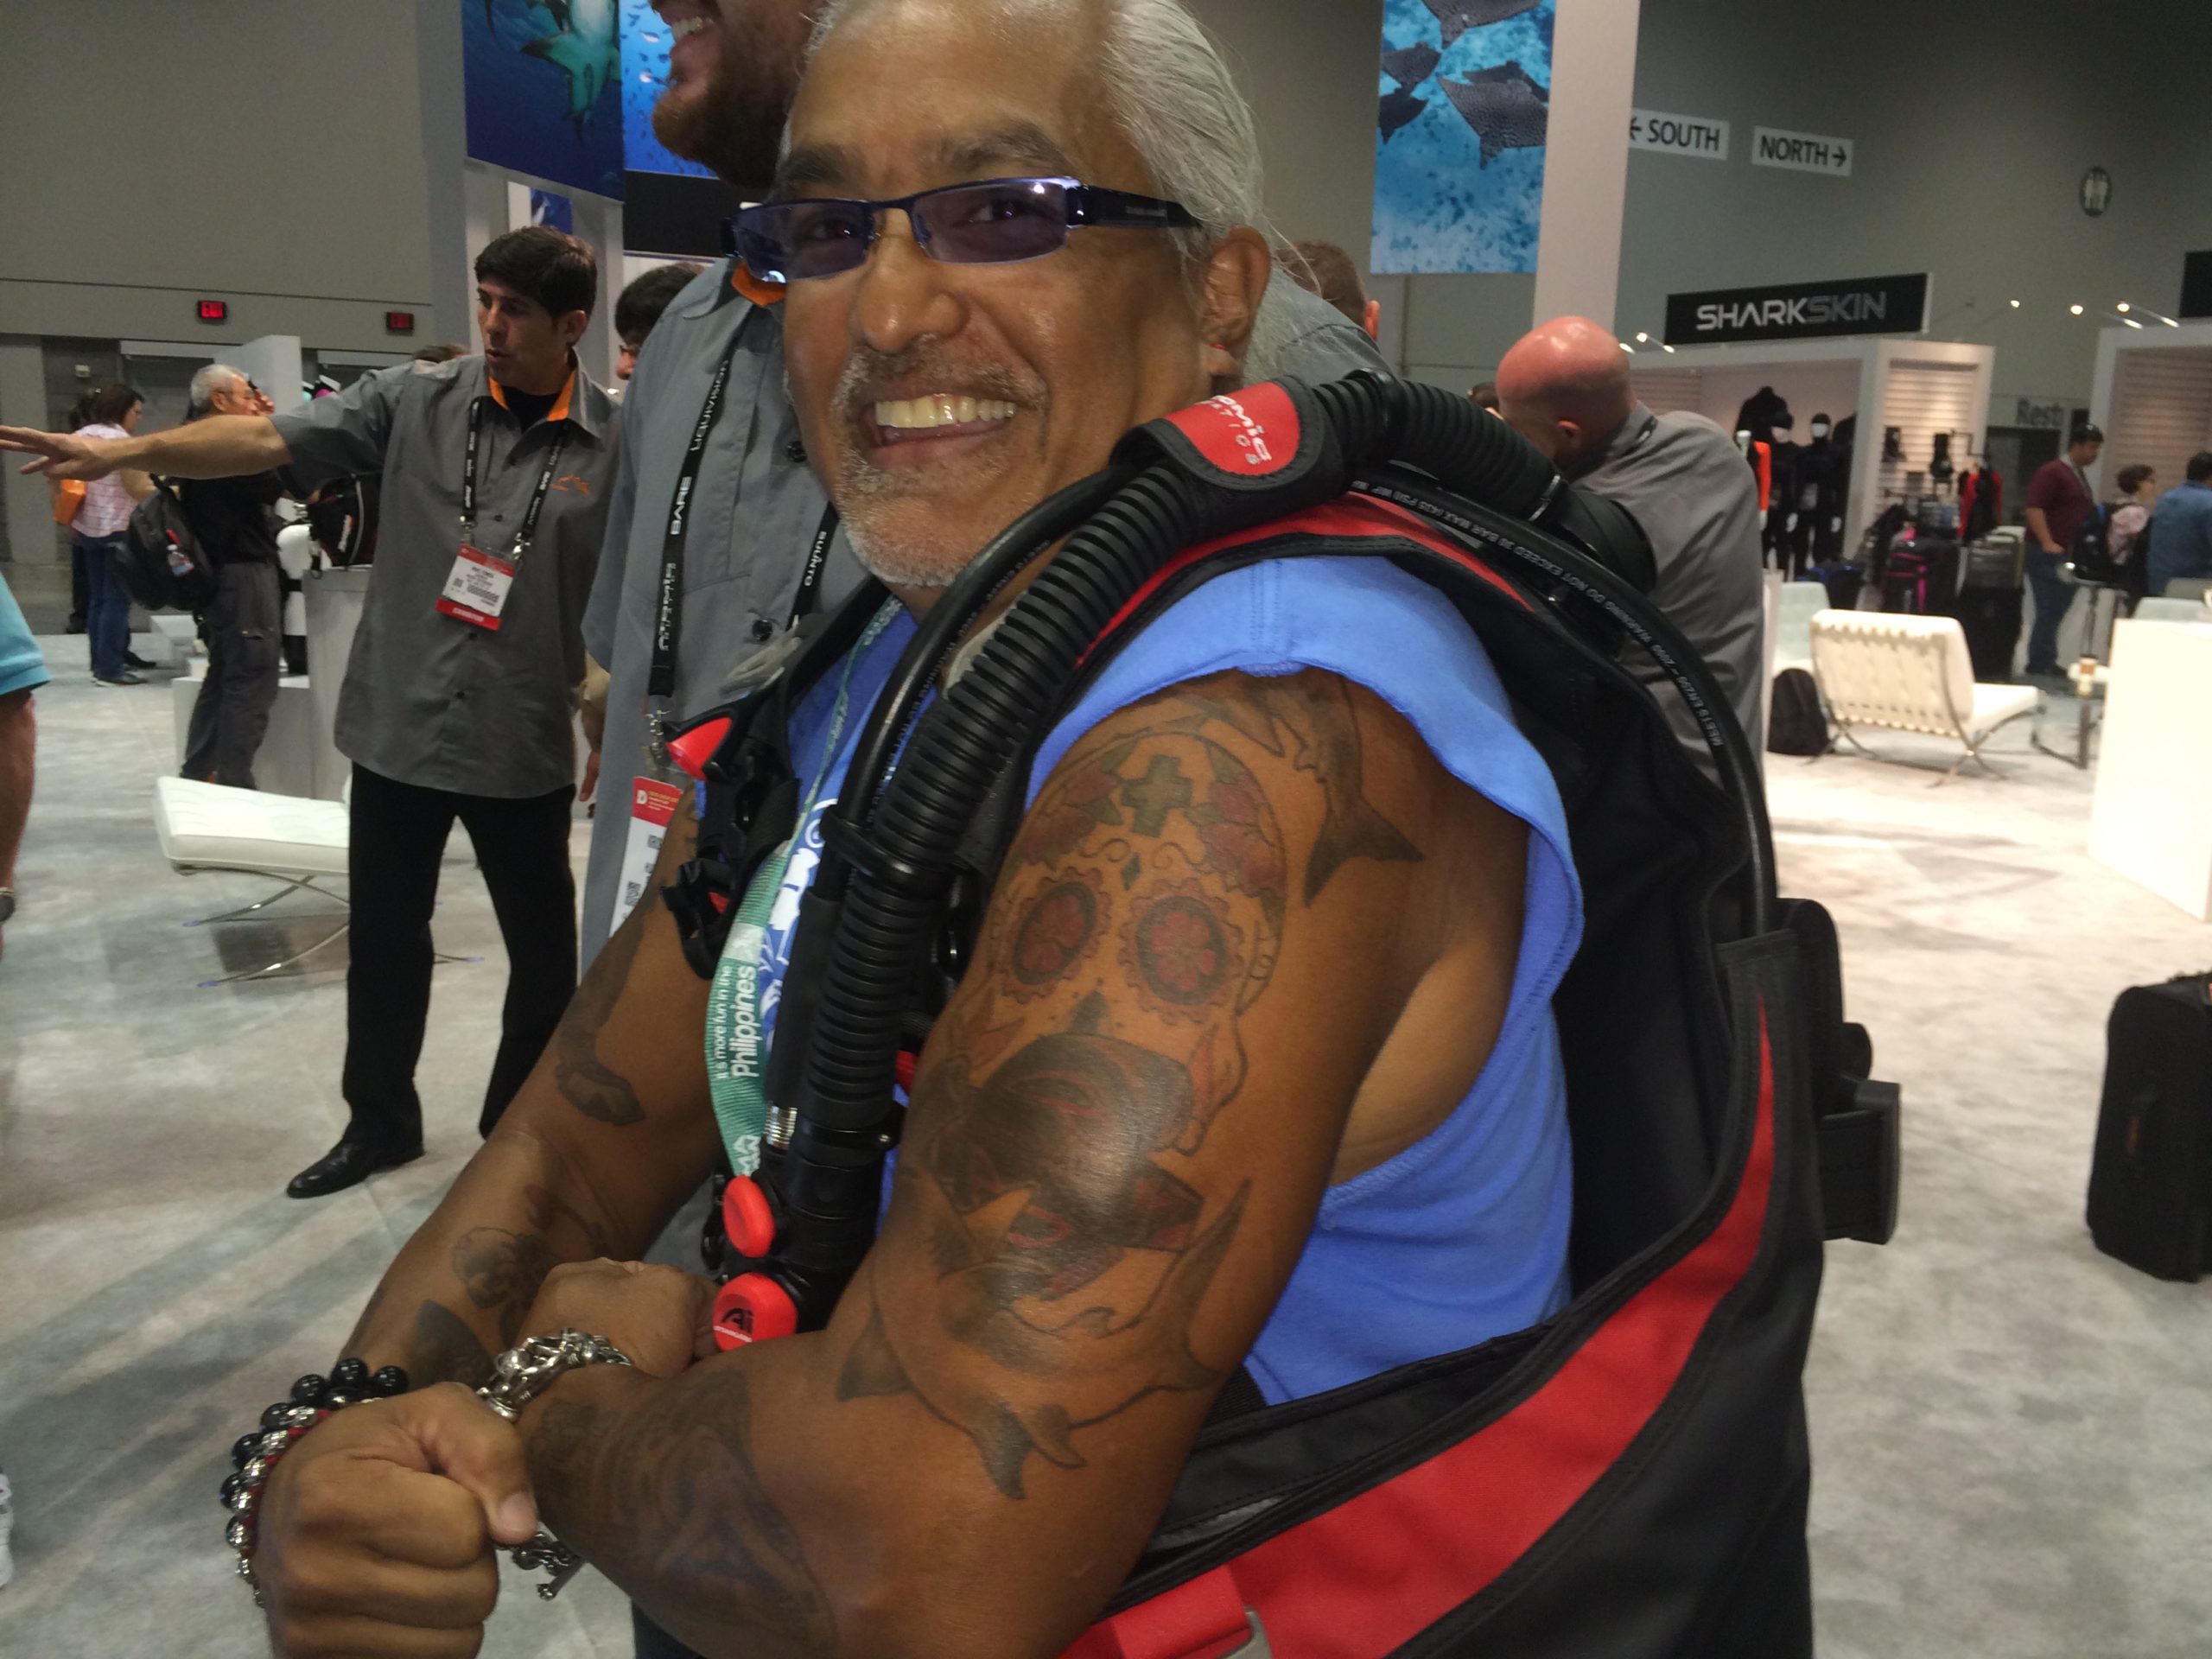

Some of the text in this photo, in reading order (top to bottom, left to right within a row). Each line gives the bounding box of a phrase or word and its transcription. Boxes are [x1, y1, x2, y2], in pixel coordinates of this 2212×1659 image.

[1646, 118, 1720, 151] SOUTH
[1759, 134, 1827, 166] NORTH
[1696, 291, 1886, 331] SHARKSKIN
[670, 476, 692, 535] BARE
[1470, 524, 1499, 543] BAR
[804, 531, 827, 586] SUUNTO
[1513, 546, 1563, 575] EXCEED
[716, 988, 730, 1001] in
[713, 1002, 728, 1023] fun
[728, 965, 763, 1077] Philippines
[714, 1025, 728, 1059] more
